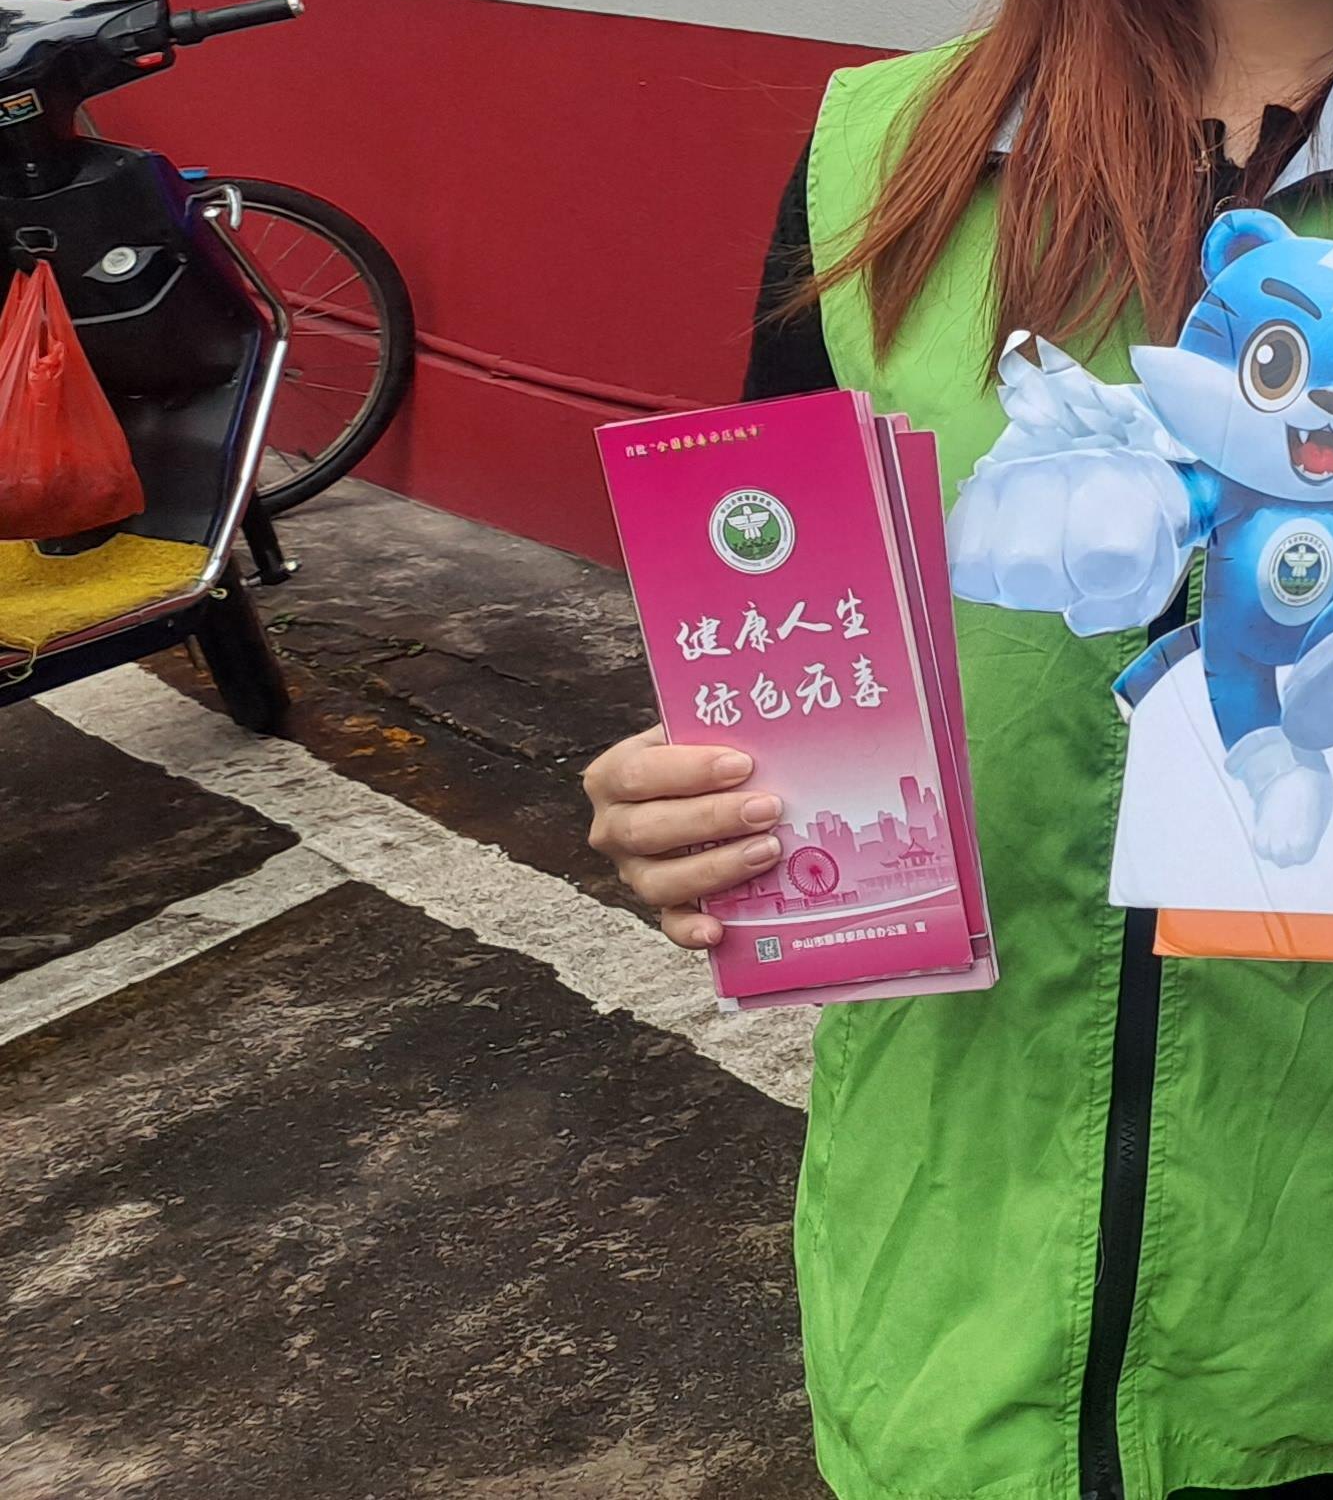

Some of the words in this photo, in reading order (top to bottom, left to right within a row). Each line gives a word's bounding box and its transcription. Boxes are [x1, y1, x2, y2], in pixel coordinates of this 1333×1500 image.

[675, 587, 871, 660] 健康人生
[694, 653, 889, 727] 绿色无毒
